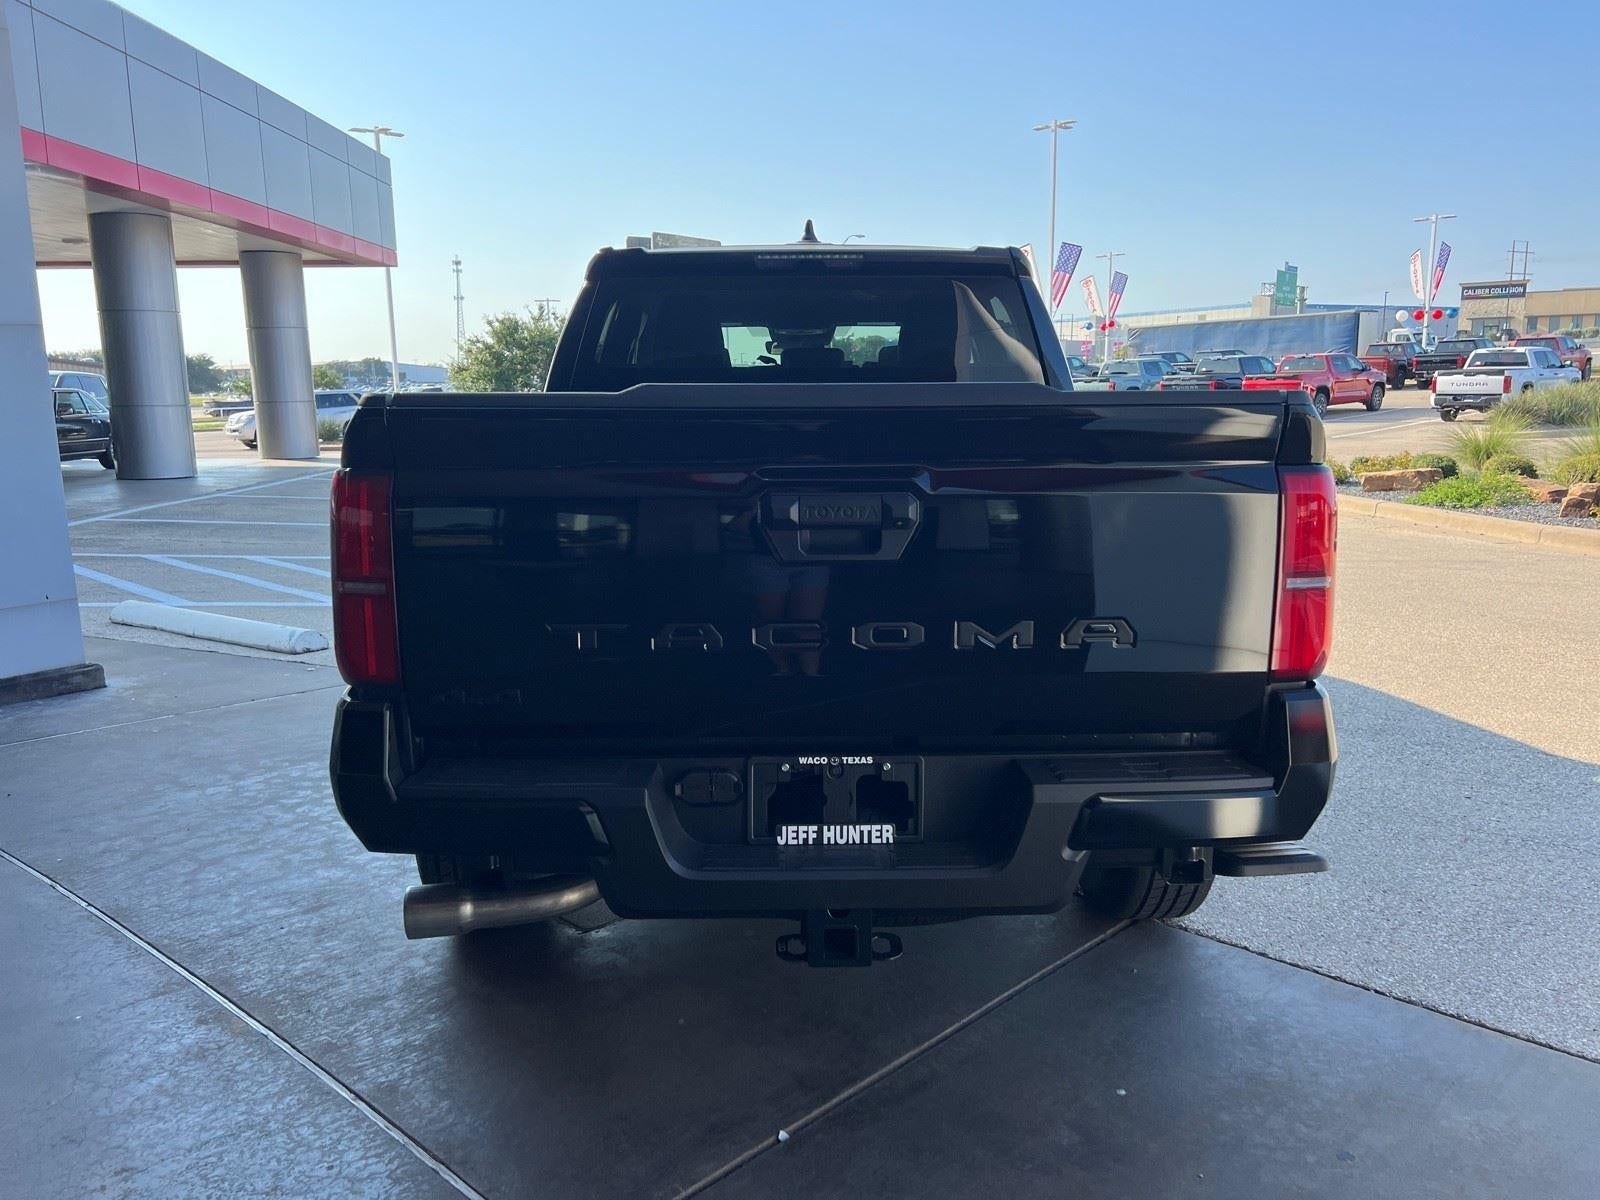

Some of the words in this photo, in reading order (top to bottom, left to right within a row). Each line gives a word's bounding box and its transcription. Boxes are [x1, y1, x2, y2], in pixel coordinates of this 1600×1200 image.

[1463, 287, 1490, 296] CALIBER
[802, 504, 879, 521] TOYOTA
[545, 616, 1138, 652] TACOMA
[798, 756, 828, 765] WACO
[841, 756, 873, 765] TEXAS
[776, 825, 818, 846] JEFF
[822, 824, 894, 845] HUNTER
